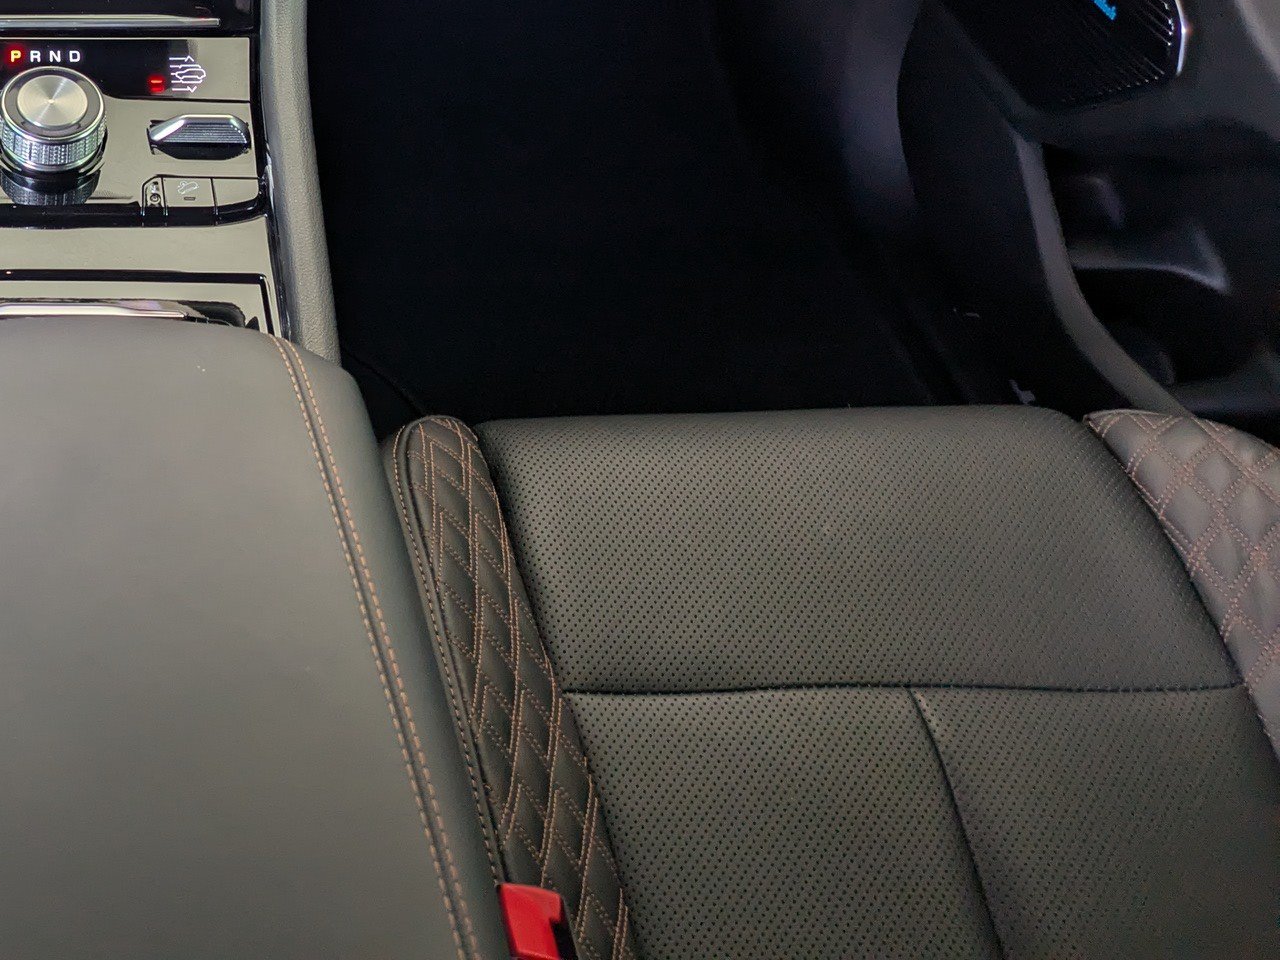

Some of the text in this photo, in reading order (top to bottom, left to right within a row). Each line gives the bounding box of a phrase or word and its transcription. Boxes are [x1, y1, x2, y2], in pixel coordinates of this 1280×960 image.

[10, 50, 81, 62] P R N D
